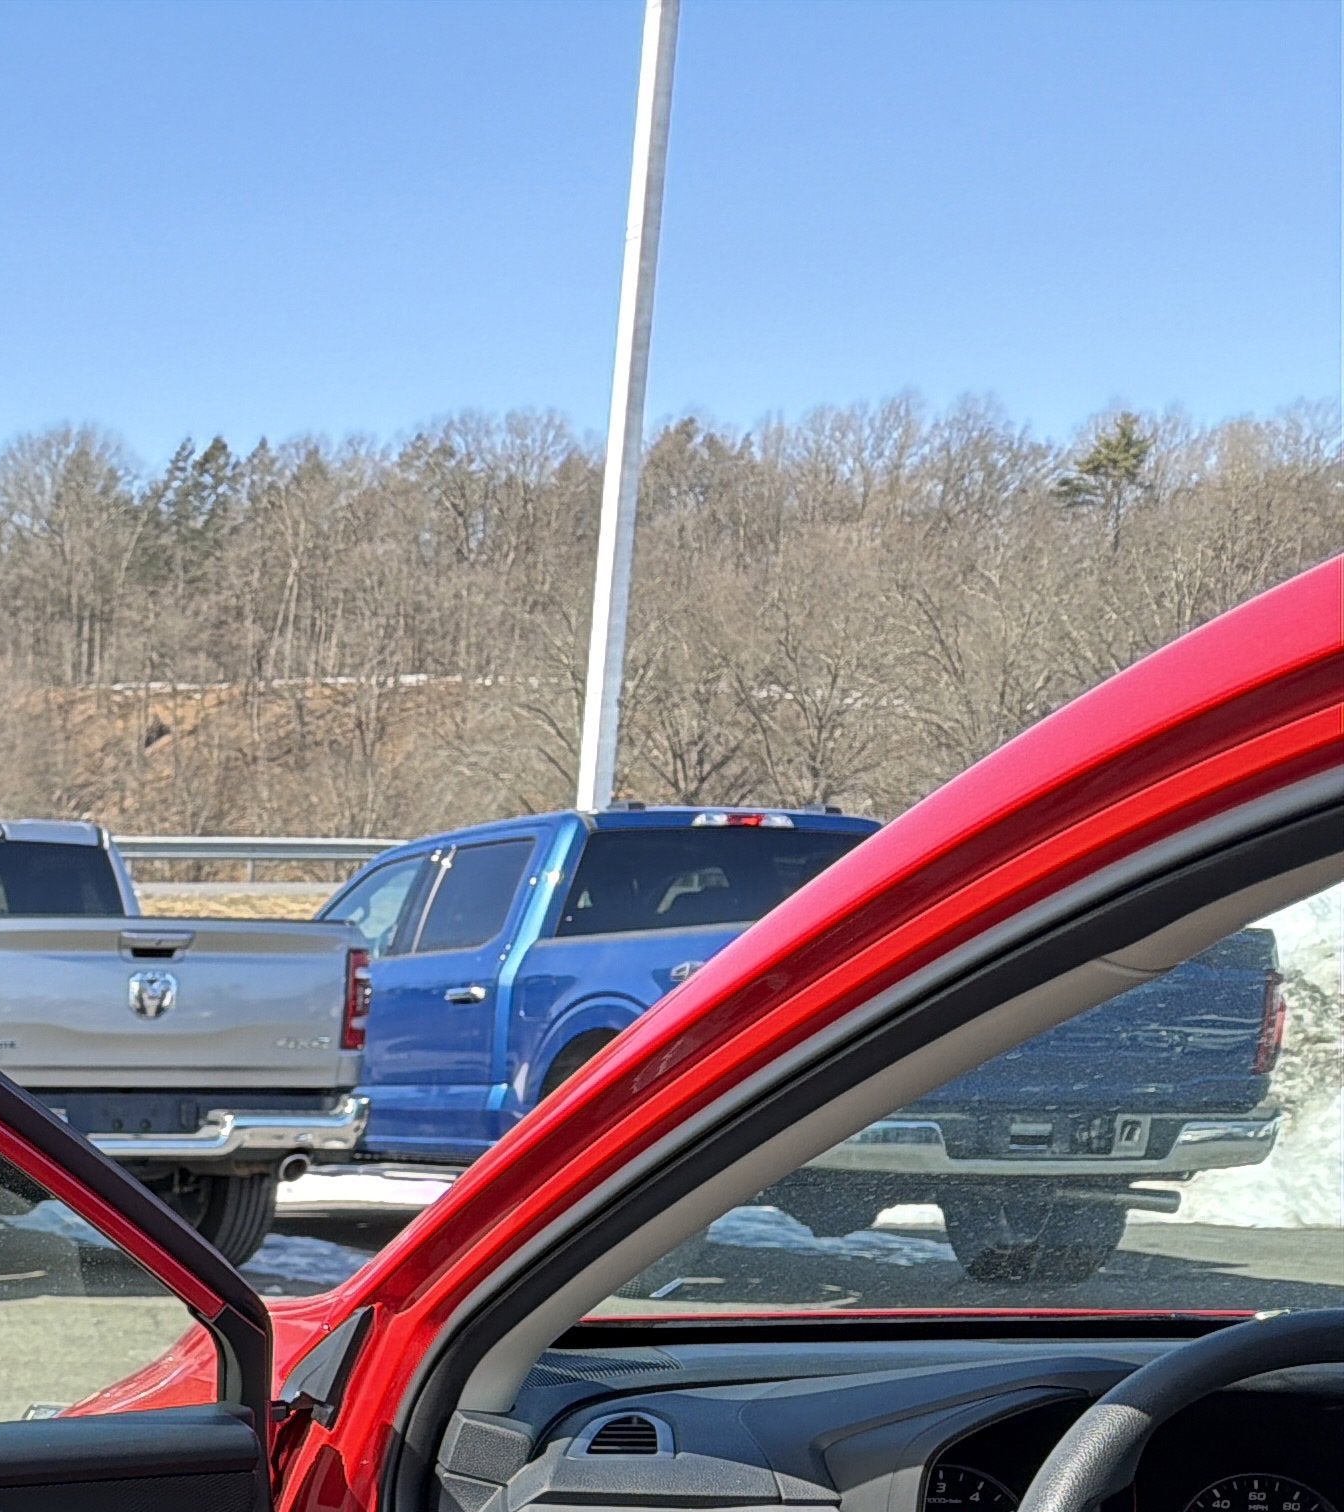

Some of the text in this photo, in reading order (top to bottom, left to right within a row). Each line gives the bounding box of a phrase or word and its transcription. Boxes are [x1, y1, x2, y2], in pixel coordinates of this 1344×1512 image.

[936, 1482, 946, 1493] 3
[969, 1491, 980, 1502] 4
[1248, 1492, 1266, 1501] 60
[1212, 1500, 1231, 1509] 40
[1248, 1504, 1269, 1512] MPH
[1282, 1502, 1301, 1511] 80
